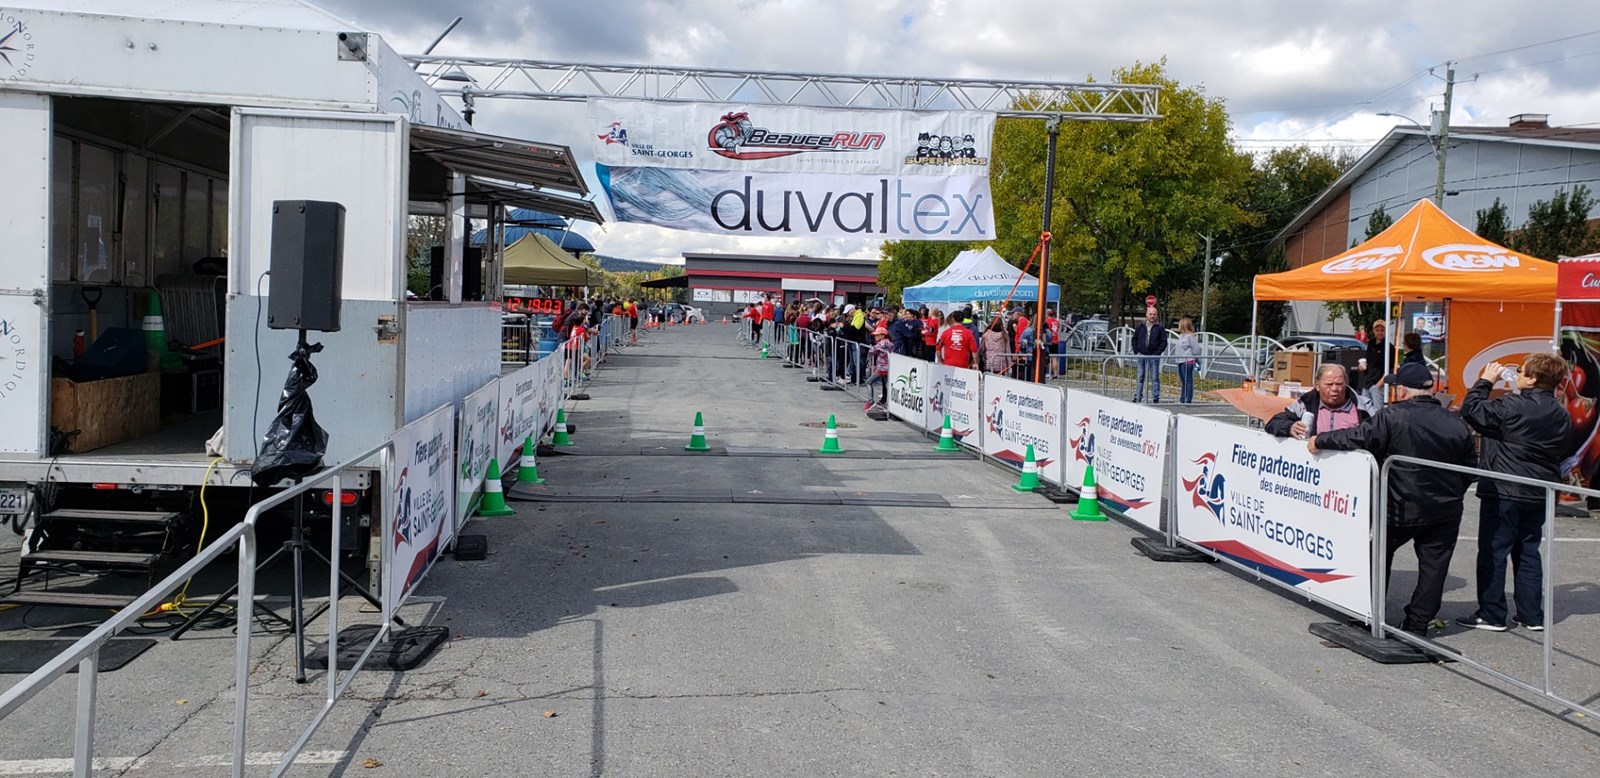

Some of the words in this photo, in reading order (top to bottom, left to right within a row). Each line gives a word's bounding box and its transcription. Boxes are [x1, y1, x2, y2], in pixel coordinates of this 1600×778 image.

[632, 148, 693, 158] SAINT-GEORGES
[711, 175, 986, 235] duvaltex
[1442, 253, 1520, 268] A&W
[901, 387, 923, 413] Beauce
[1018, 395, 1043, 411] partenaire
[1097, 409, 1110, 427] Fière
[1110, 416, 1143, 437] partenaire
[1005, 428, 1049, 453] SAINT-GEORGES
[1096, 458, 1145, 492] SAINT-GEORGES
[1231, 443, 1257, 469] Fière
[1258, 455, 1320, 486] partenaire
[1230, 490, 1251, 509] VILLE
[1254, 498, 1265, 514] DE
[1260, 477, 1273, 493] des
[1274, 480, 1322, 507] événements
[1323, 489, 1349, 515] d'ici
[1229, 507, 1334, 560] SAINT-GEORGES
